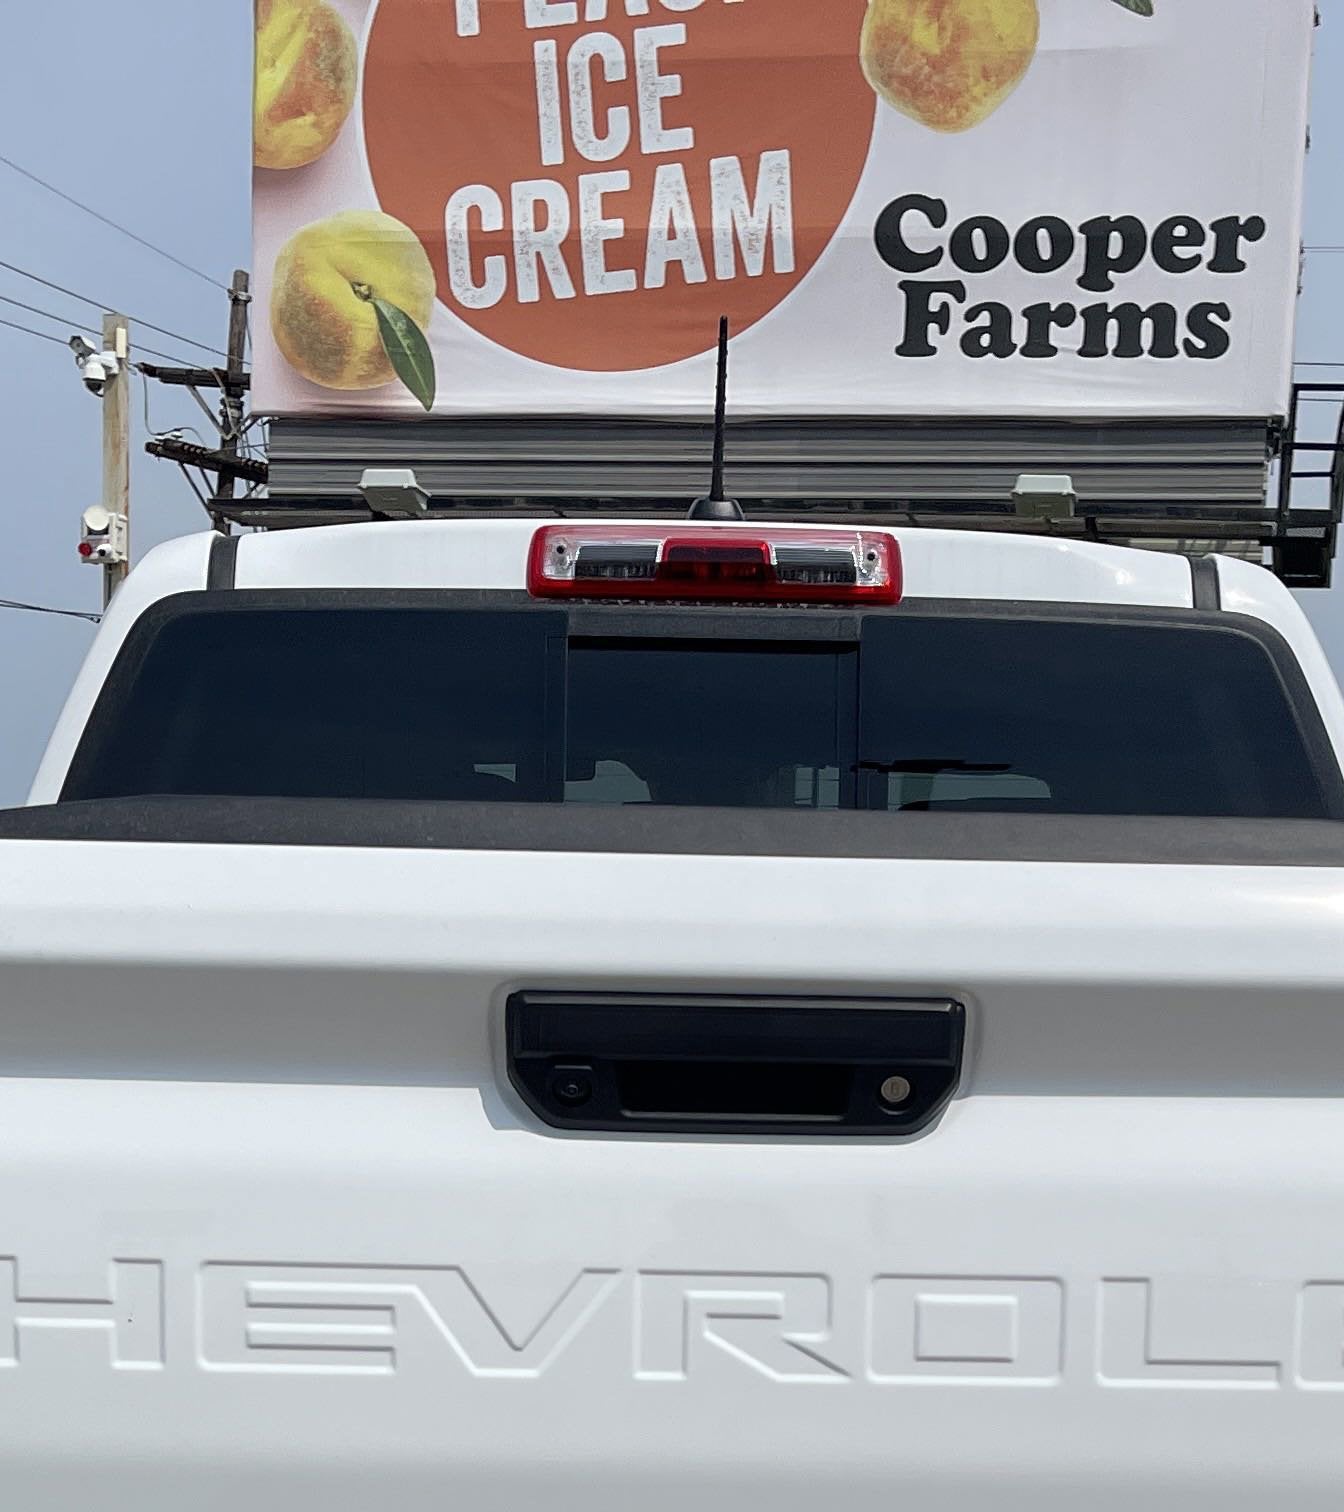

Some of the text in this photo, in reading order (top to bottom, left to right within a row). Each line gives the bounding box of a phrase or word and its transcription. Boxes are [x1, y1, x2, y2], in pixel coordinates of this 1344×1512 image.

[534, 22, 695, 167] ICE
[443, 149, 795, 311] CREAM
[873, 193, 1267, 292] Cooper
[895, 279, 1232, 360] Farms
